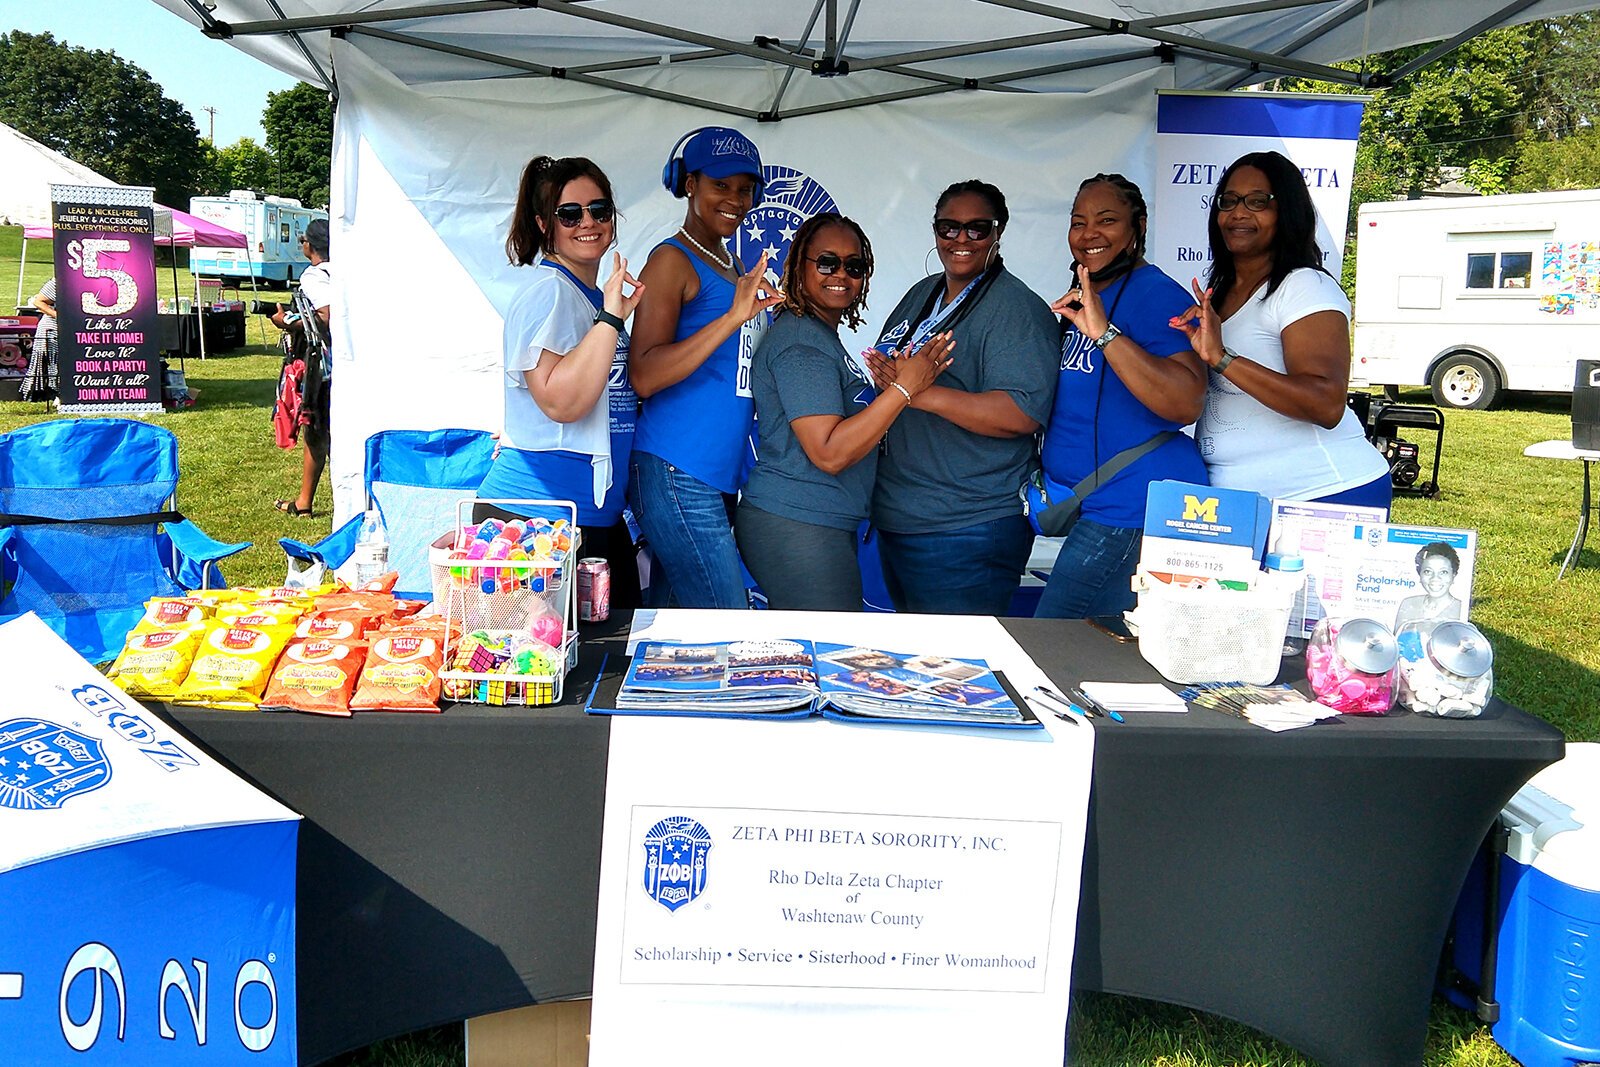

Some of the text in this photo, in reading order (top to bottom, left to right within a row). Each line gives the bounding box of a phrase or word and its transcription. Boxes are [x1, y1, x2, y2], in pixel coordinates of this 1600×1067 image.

[1172, 164, 1226, 185] ZET
[95, 208, 138, 217] NICKEL-FREE
[59, 214, 90, 222] JEWELRY
[98, 217, 148, 225] ACCESSORIES
[1177, 247, 1203, 262] Rho
[67, 238, 138, 316] $5
[85, 318, 133, 330] Like It?
[75, 333, 143, 344] TAKE IT HOME!
[85, 347, 136, 358] Love It?
[742, 334, 752, 359] IS
[76, 361, 146, 372] BOOK A PARTY!
[73, 374, 149, 386] Want It all?
[78, 388, 146, 400] JOIN MY TEAM!
[1182, 494, 1219, 522] M
[1358, 574, 1416, 588] Scholarship
[1356, 584, 1380, 593] Fund
[732, 826, 1007, 851] ZETA PHI BETA SORORITY, INC.
[769, 870, 944, 892] Rho Delta Zeta Chapter
[846, 892, 861, 904] of
[782, 908, 924, 929] Washtenaw County
[634, 947, 1036, 969] Scholarship Service Sisterhood Finer Womanhood
